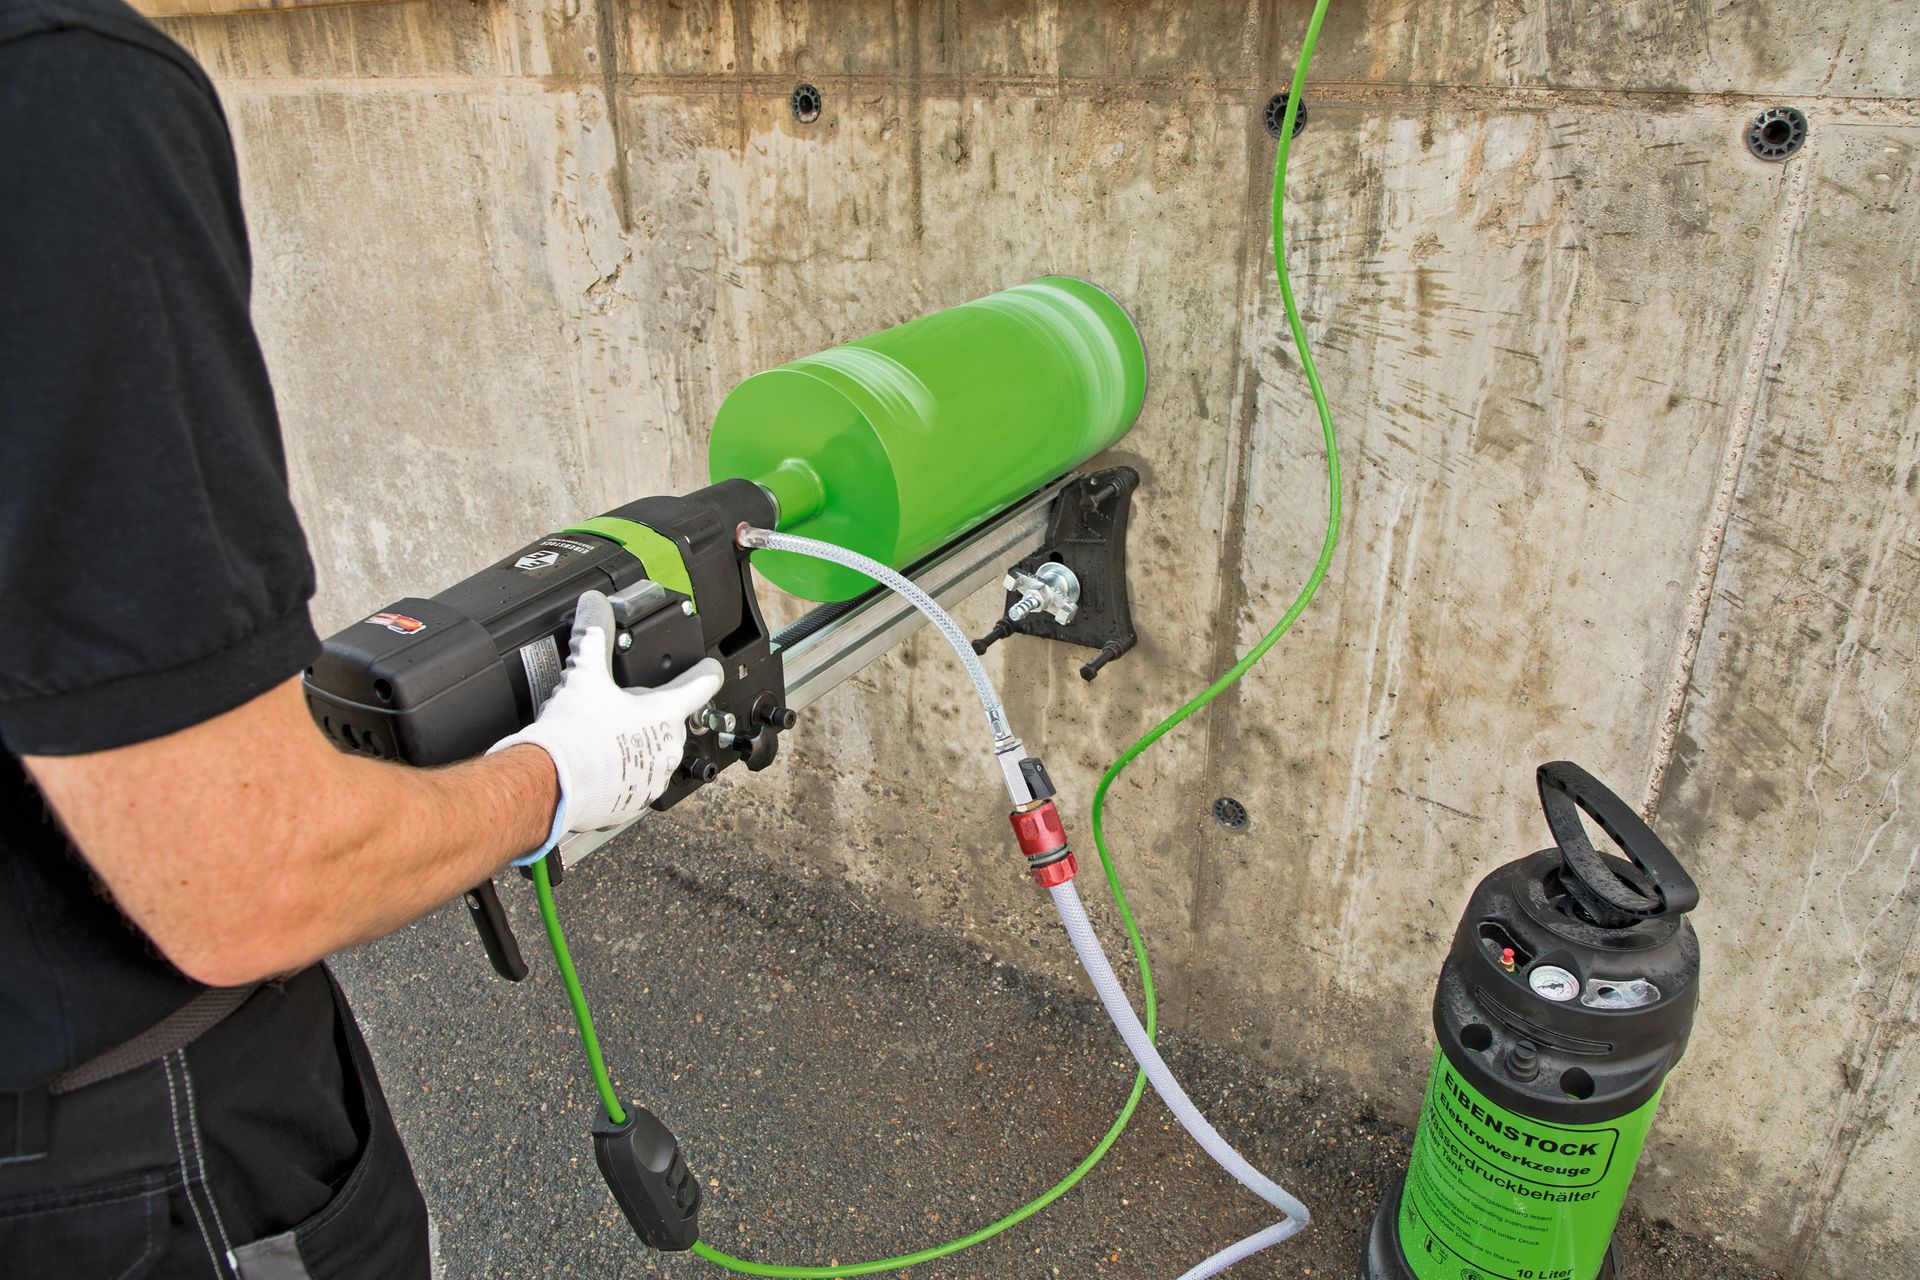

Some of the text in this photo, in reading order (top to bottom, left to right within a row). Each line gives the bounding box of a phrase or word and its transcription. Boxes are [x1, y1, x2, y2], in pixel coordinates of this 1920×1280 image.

[1444, 1070, 1599, 1156] EIBENSTOCK
[1440, 1091, 1591, 1178] Elektrowerkzeuge
[1429, 1101, 1600, 1203] Wasserdruckbehälter
[1442, 1149, 1465, 1175] Tank
[1470, 1201, 1503, 1222] operating
[1497, 1231, 1517, 1242] unter
[1516, 1268, 1574, 1280] 10 Liter
